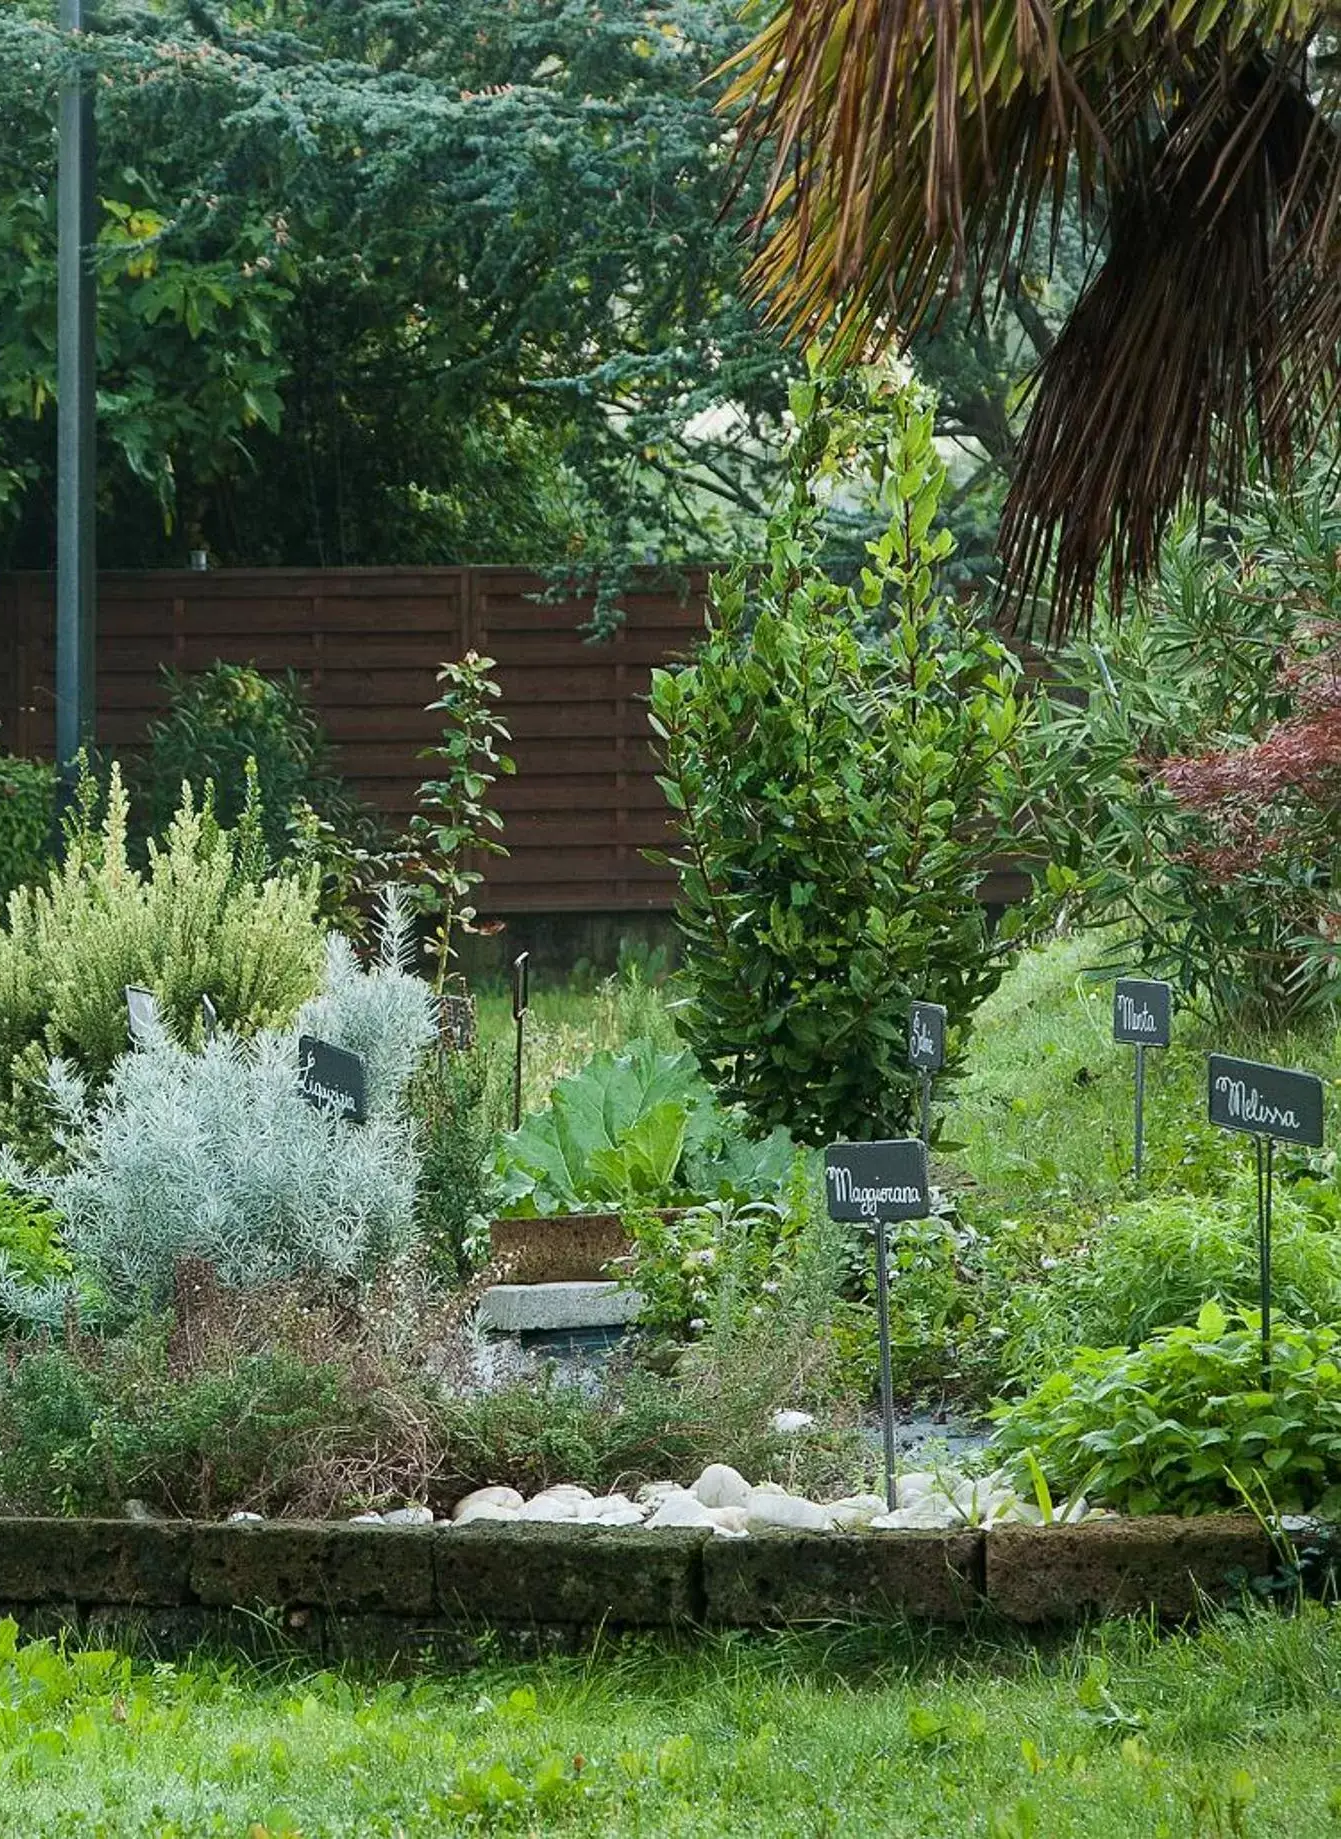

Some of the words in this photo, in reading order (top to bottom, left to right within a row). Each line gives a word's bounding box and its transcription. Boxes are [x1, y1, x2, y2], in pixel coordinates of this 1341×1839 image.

[1117, 994, 1157, 1032] Menta
[1215, 1076, 1300, 1129] Melissa
[825, 1166, 921, 1215] Maggiorana
